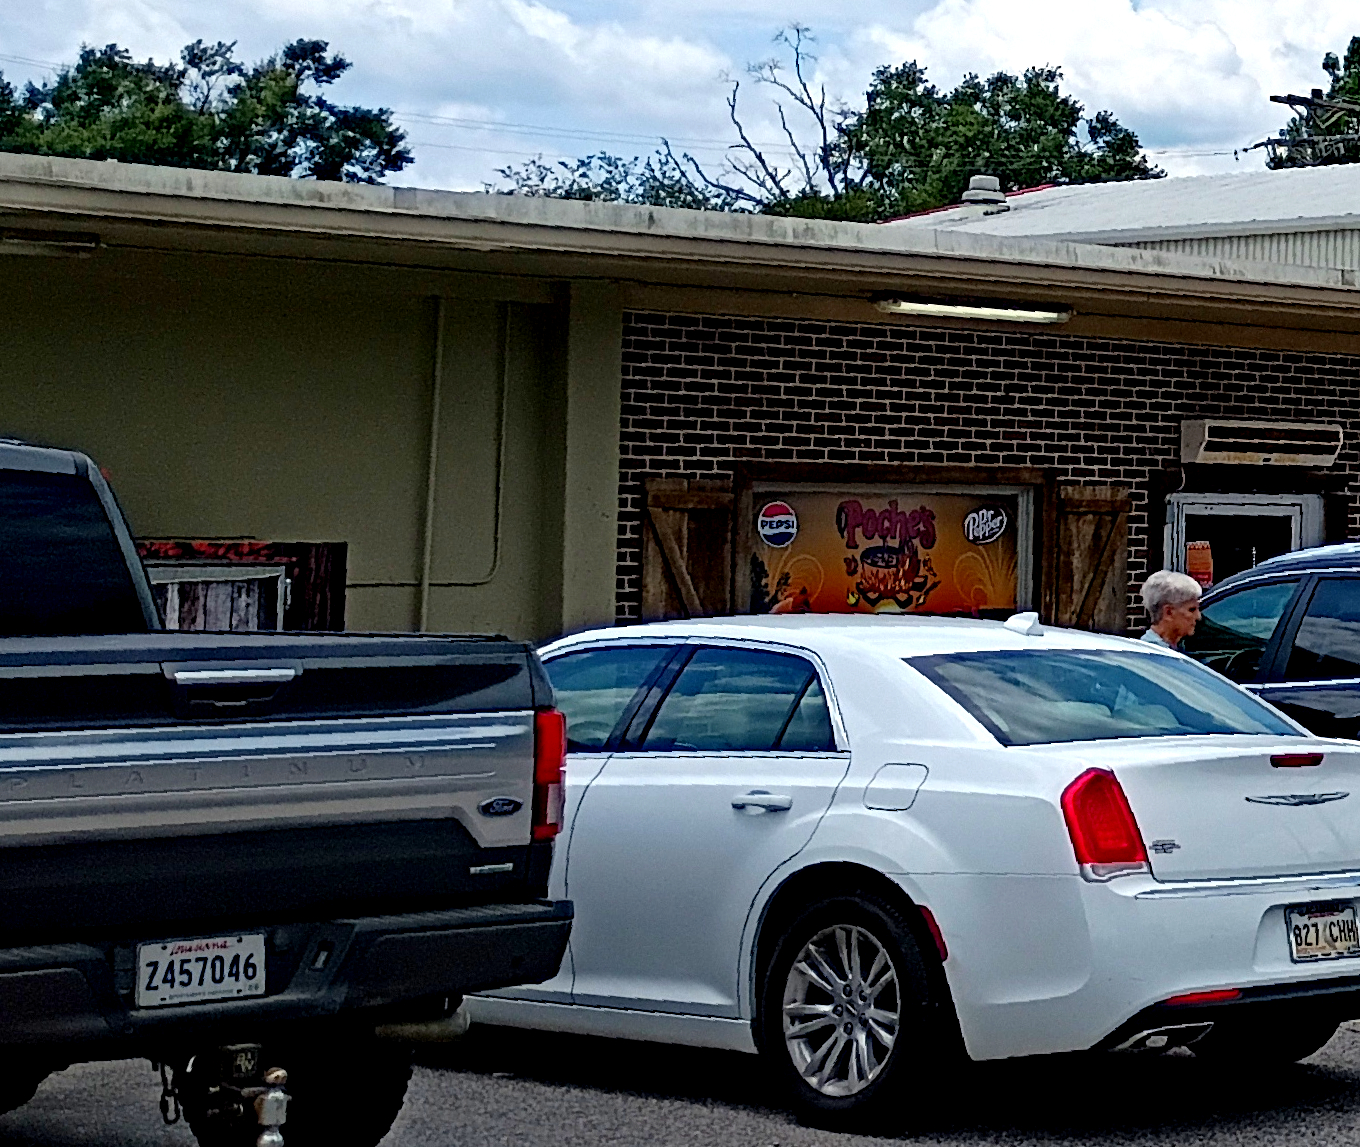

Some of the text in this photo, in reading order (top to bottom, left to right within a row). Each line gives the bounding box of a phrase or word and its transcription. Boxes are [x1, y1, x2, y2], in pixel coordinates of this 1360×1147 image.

[760, 519, 795, 530] PEPSI
[836, 498, 936, 549] Poche's
[965, 512, 1003, 540] Pepper
[978, 508, 995, 525] Dr
[5, 754, 425, 791] PLATINUM
[1293, 922, 1319, 947] 827
[145, 953, 257, 991] Z457046
